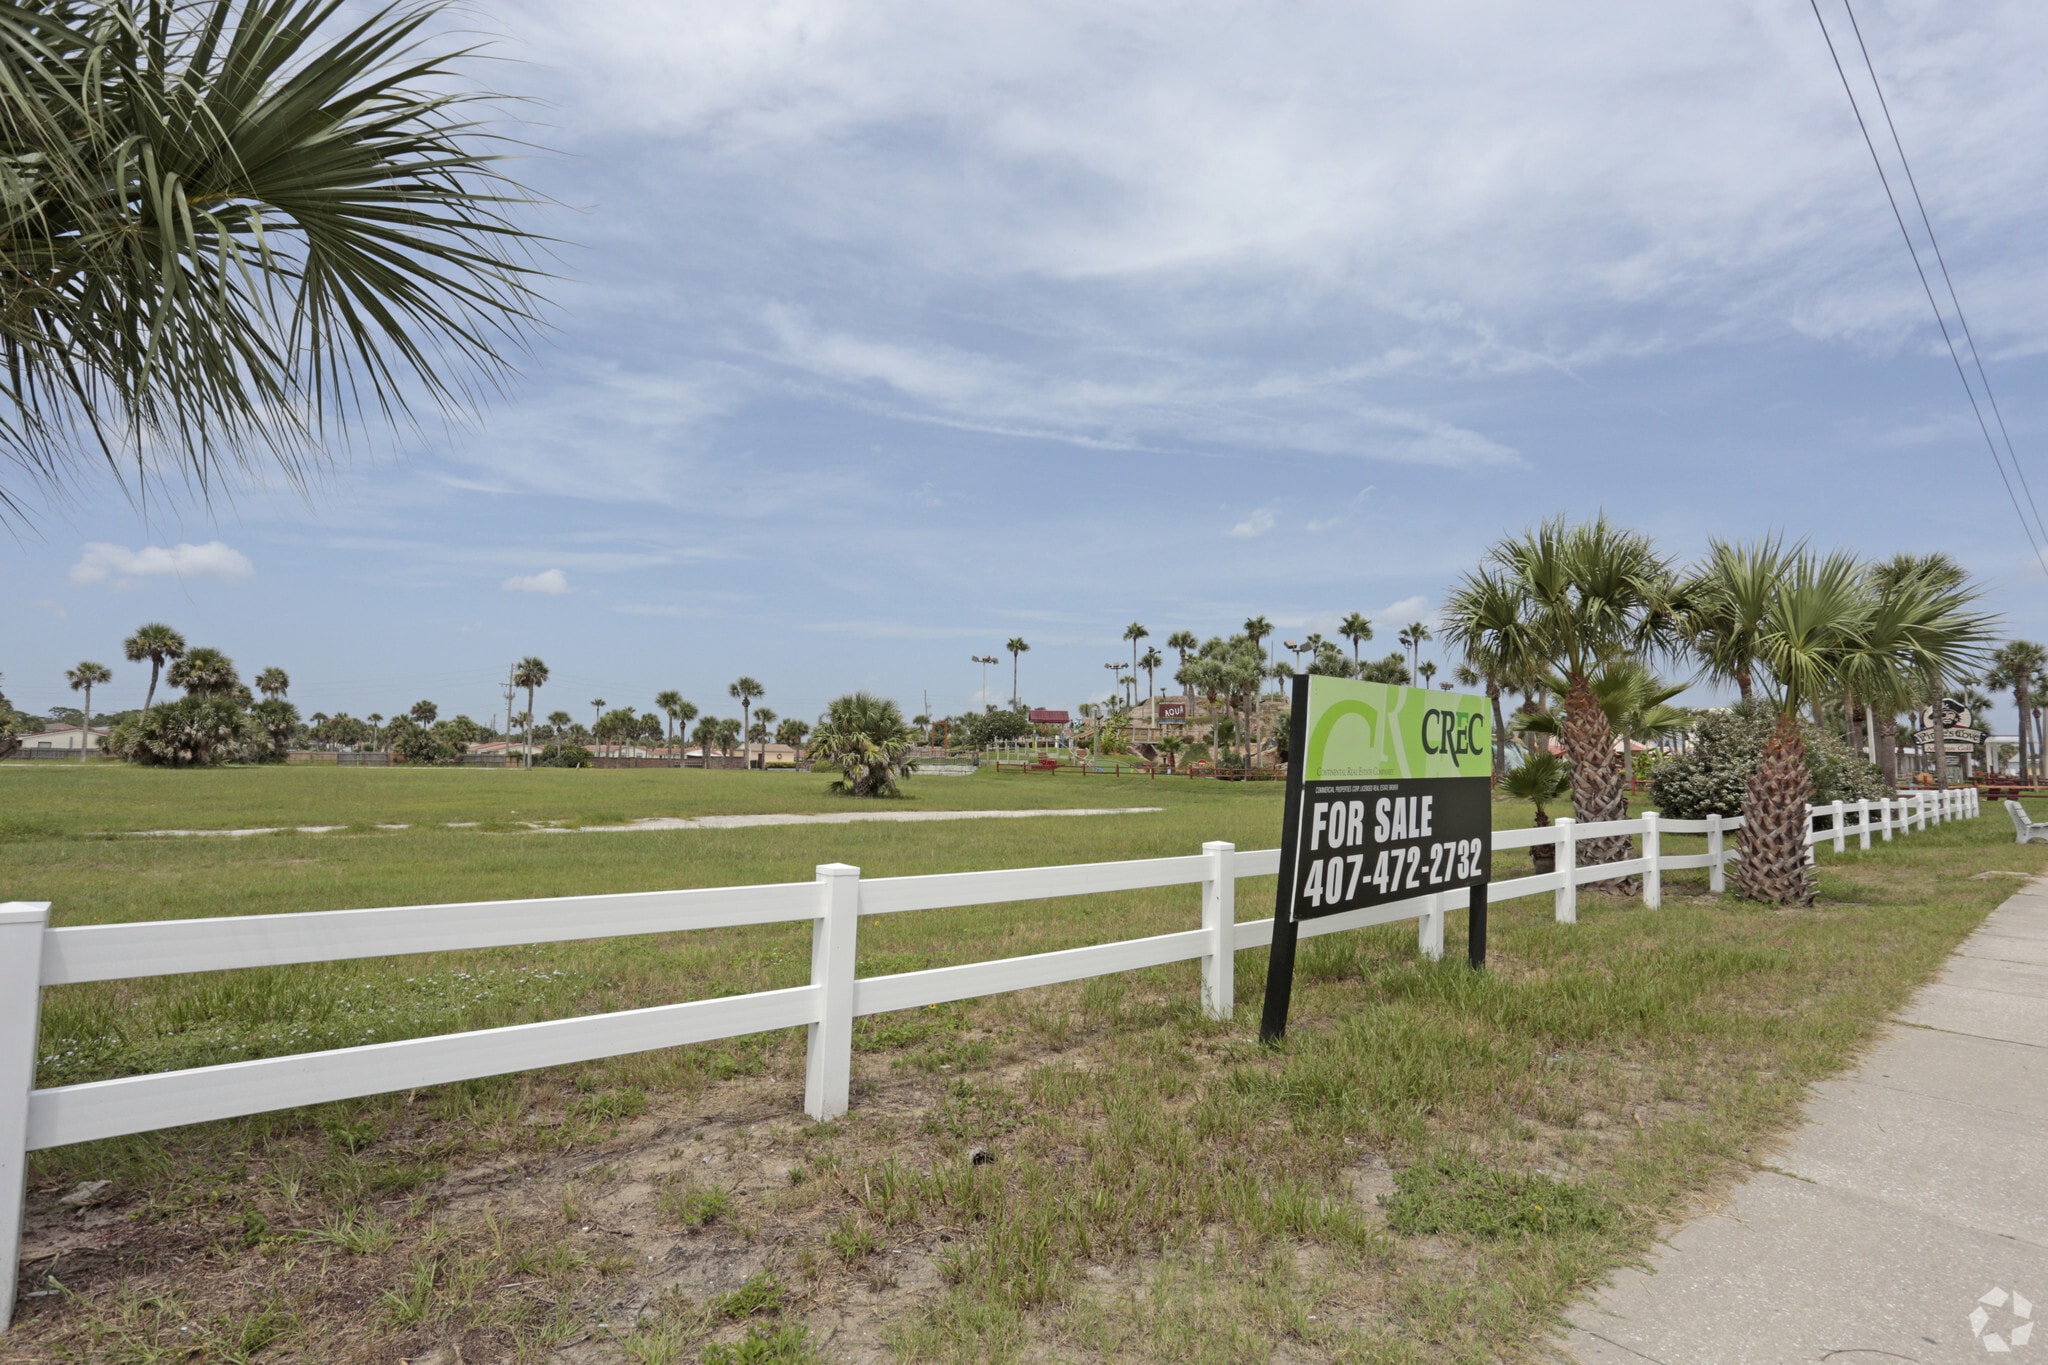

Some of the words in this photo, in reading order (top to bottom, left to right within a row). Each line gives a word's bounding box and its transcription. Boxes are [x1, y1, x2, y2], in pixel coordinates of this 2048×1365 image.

[1165, 705, 1184, 716] AQUA
[1421, 708, 1484, 768] CREC
[1310, 800, 1365, 851] FOR
[1374, 795, 1433, 844] SALE
[1303, 837, 1483, 908] 407-472-2732
